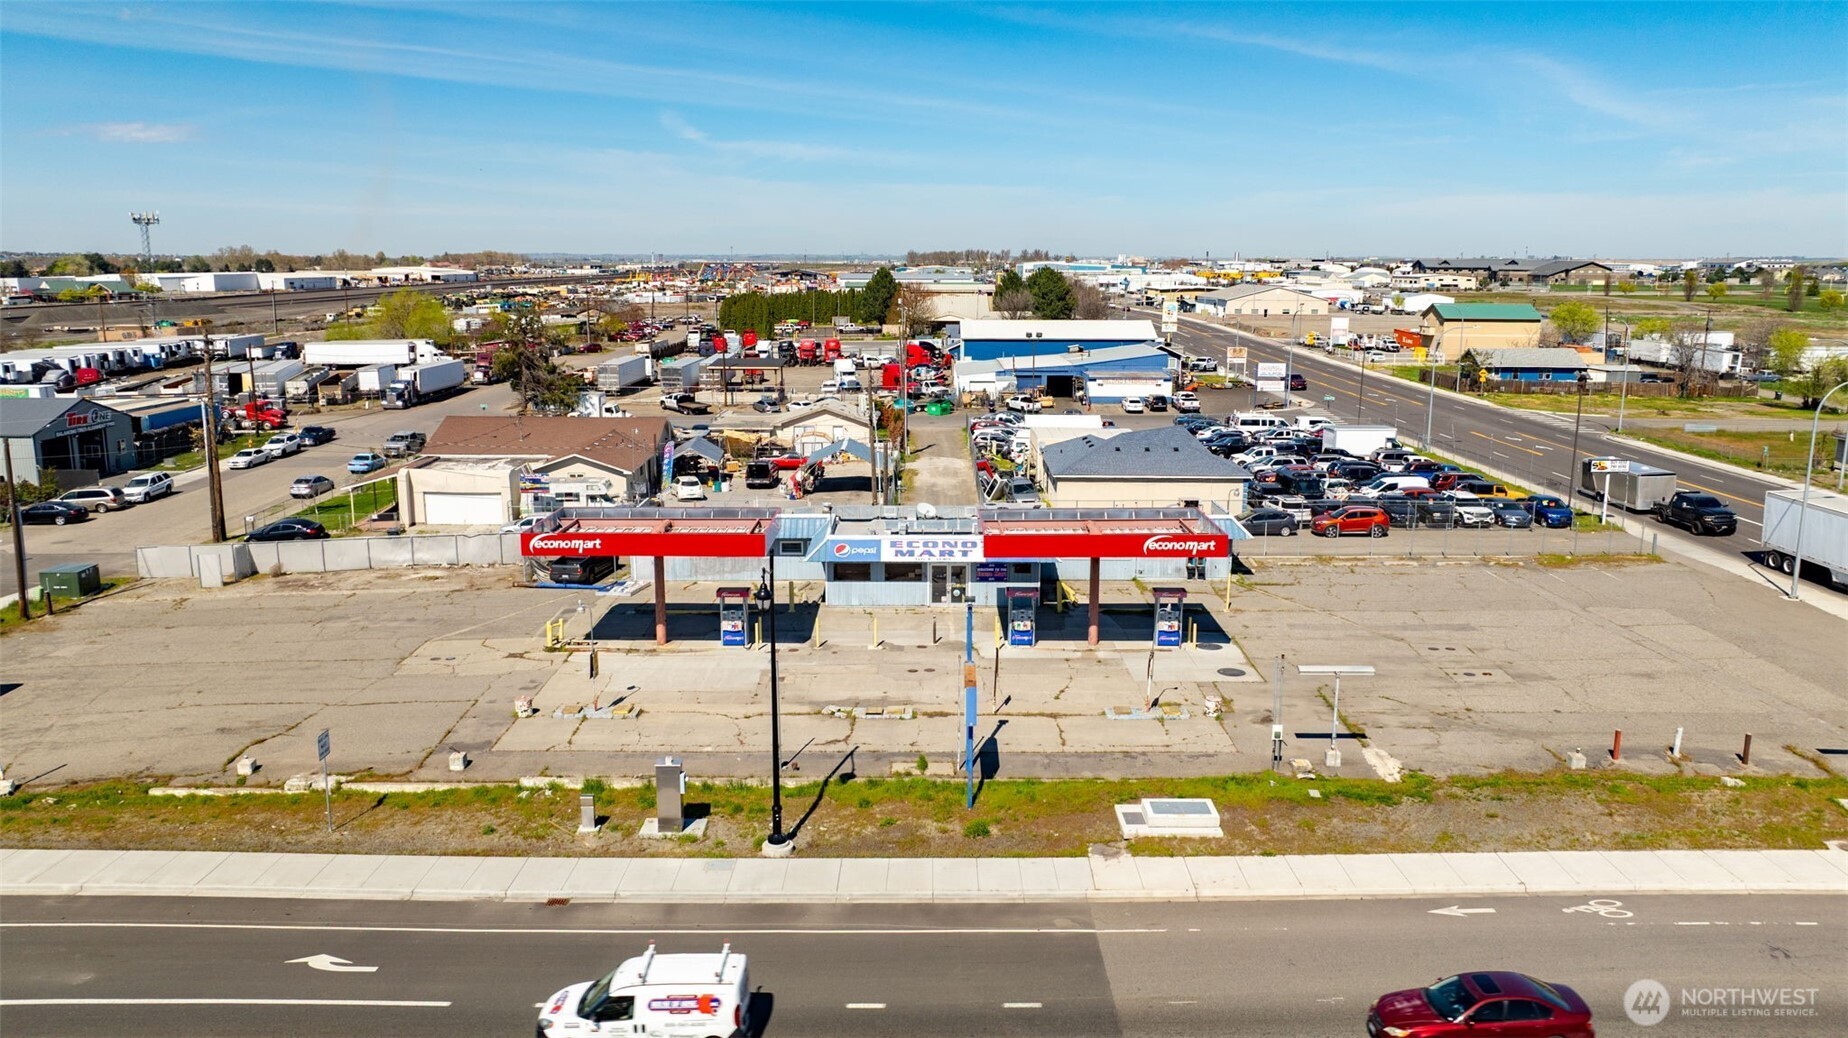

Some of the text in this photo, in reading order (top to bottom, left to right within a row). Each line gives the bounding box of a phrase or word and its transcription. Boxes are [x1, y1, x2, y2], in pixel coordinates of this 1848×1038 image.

[889, 541, 978, 549] ECONO
[851, 546, 877, 555] pepsi
[894, 550, 973, 558] MART
